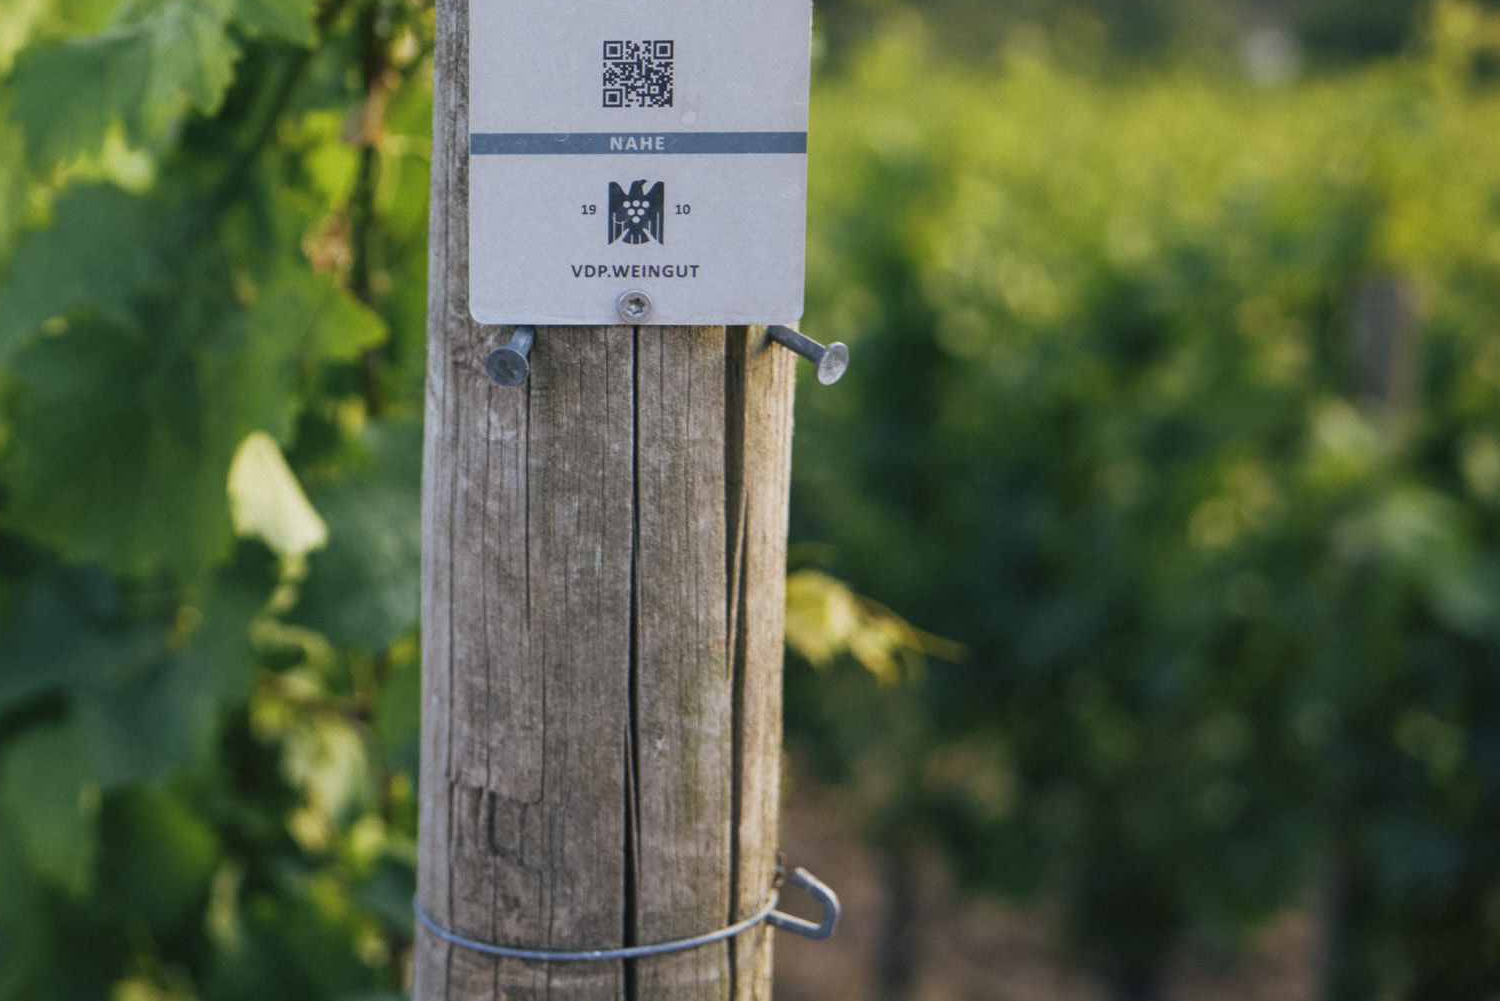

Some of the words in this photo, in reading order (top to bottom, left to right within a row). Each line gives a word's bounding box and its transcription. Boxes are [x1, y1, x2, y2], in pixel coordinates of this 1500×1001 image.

[609, 136, 665, 151] NAHE
[581, 204, 597, 215] 19
[675, 204, 691, 215] 10
[571, 264, 700, 279] VDP.WEINGUT
